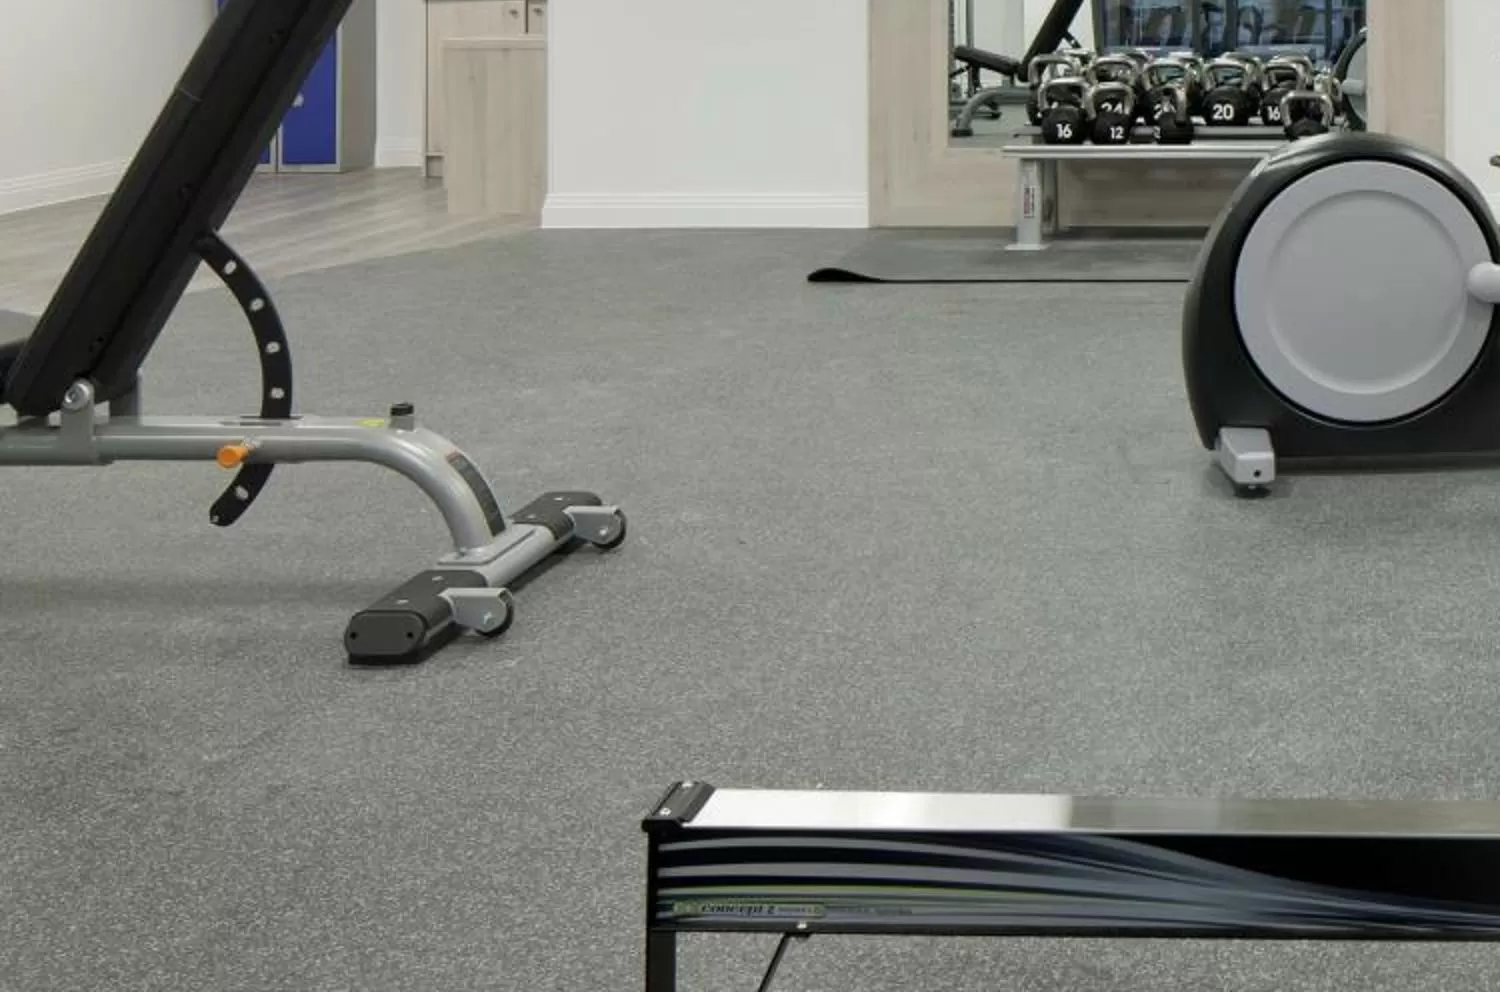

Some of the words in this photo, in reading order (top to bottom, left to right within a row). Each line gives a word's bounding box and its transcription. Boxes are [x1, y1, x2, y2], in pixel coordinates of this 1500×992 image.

[1212, 103, 1235, 121] 20
[1267, 105, 1281, 121] 16
[1056, 123, 1073, 139] 16
[1110, 126, 1125, 140] 12
